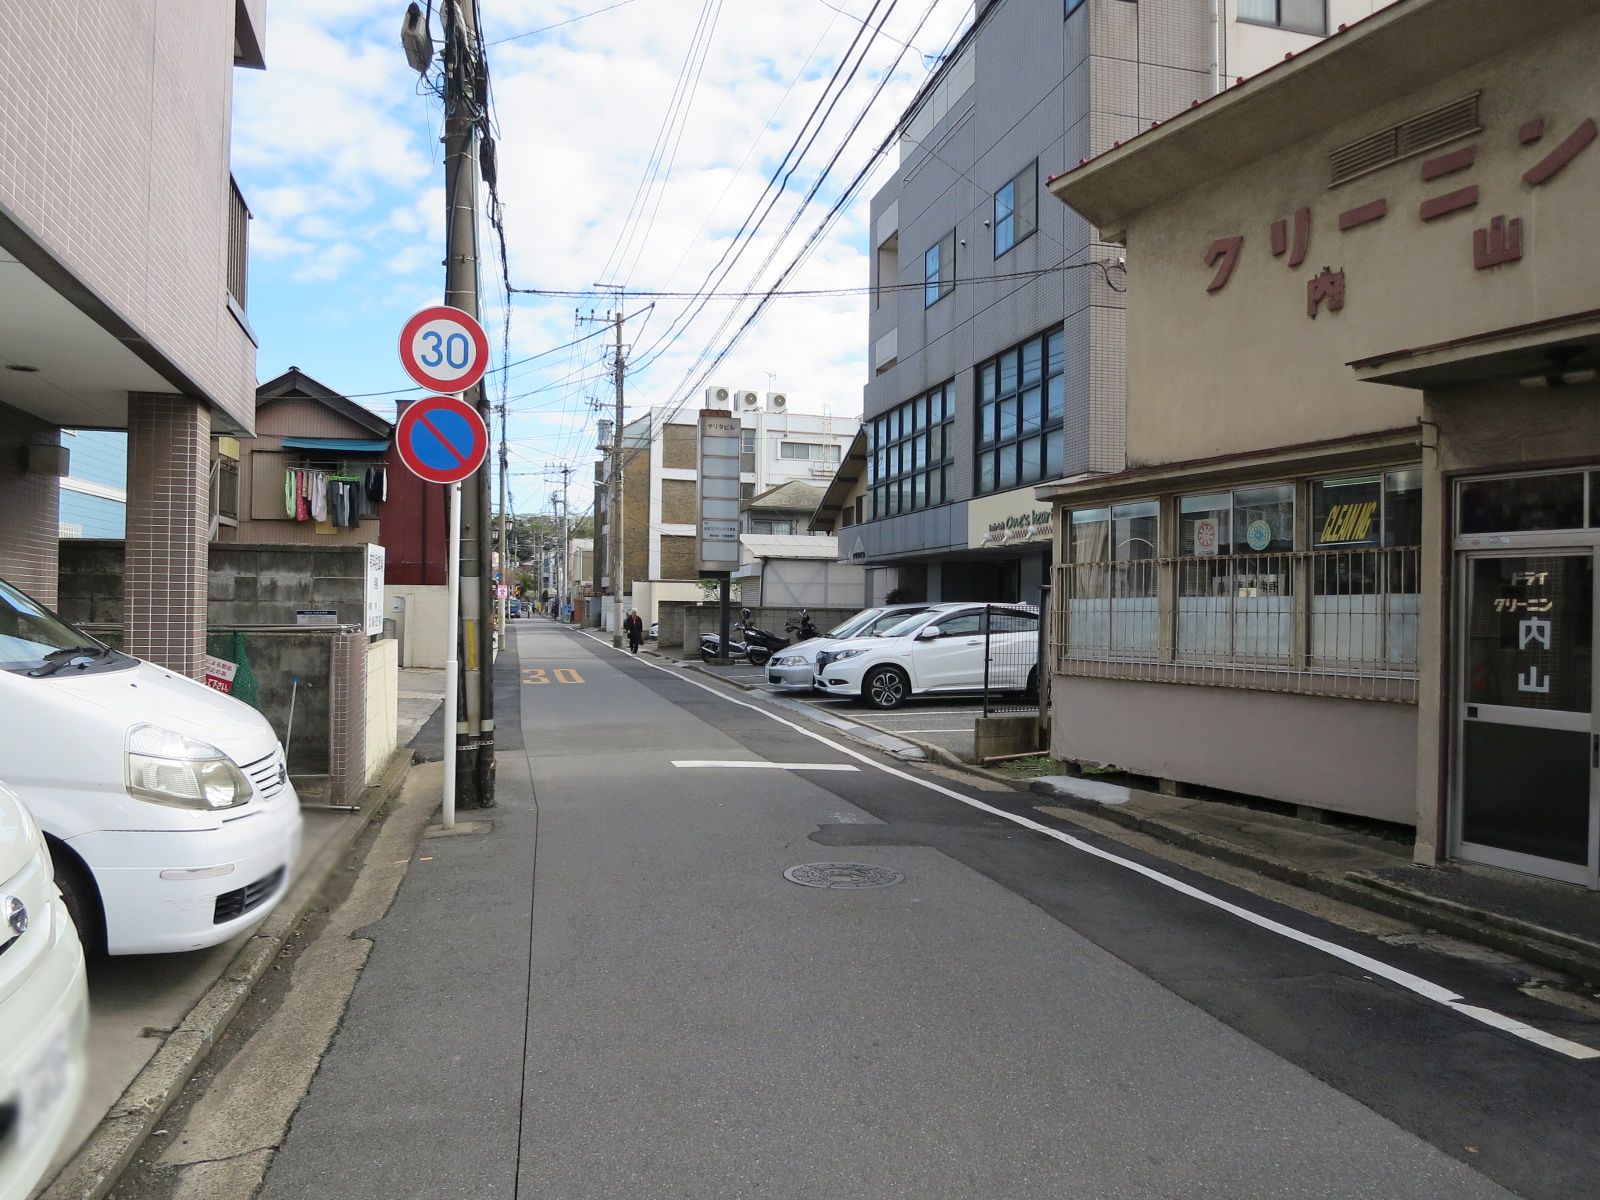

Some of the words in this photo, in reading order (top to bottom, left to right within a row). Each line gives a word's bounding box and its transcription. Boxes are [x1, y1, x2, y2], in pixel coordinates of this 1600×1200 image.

[1204, 117, 1599, 293] クリーニン
[1307, 214, 1524, 320] 内山
[421, 331, 469, 369] 30
[1320, 501, 1377, 543] CLEANING
[1511, 571, 1549, 586] ドライ
[1493, 598, 1553, 612] クリーニン
[1517, 616, 1551, 693] 内山
[521, 668, 586, 685] 30
